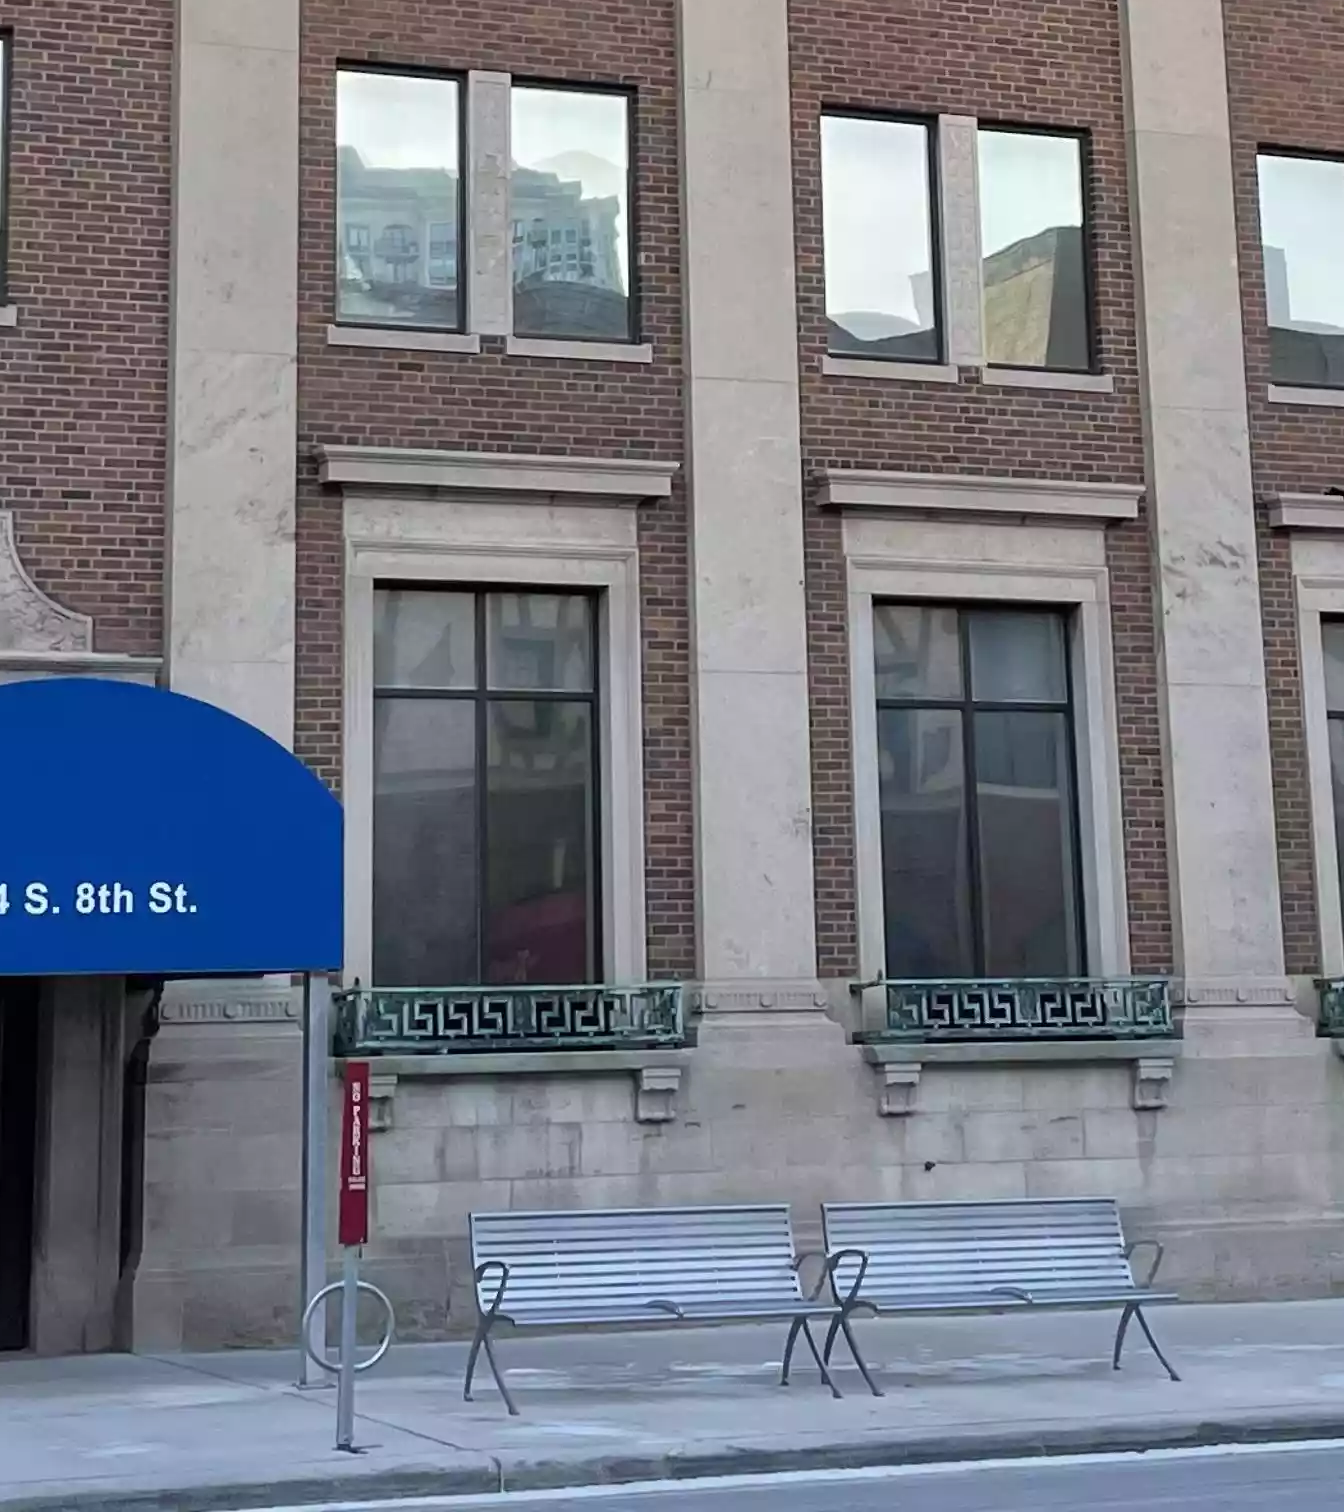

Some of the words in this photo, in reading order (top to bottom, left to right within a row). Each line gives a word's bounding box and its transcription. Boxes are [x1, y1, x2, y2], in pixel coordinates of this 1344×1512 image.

[23, 882, 60, 915] S.
[75, 882, 134, 914] 8th
[148, 881, 198, 914] St.
